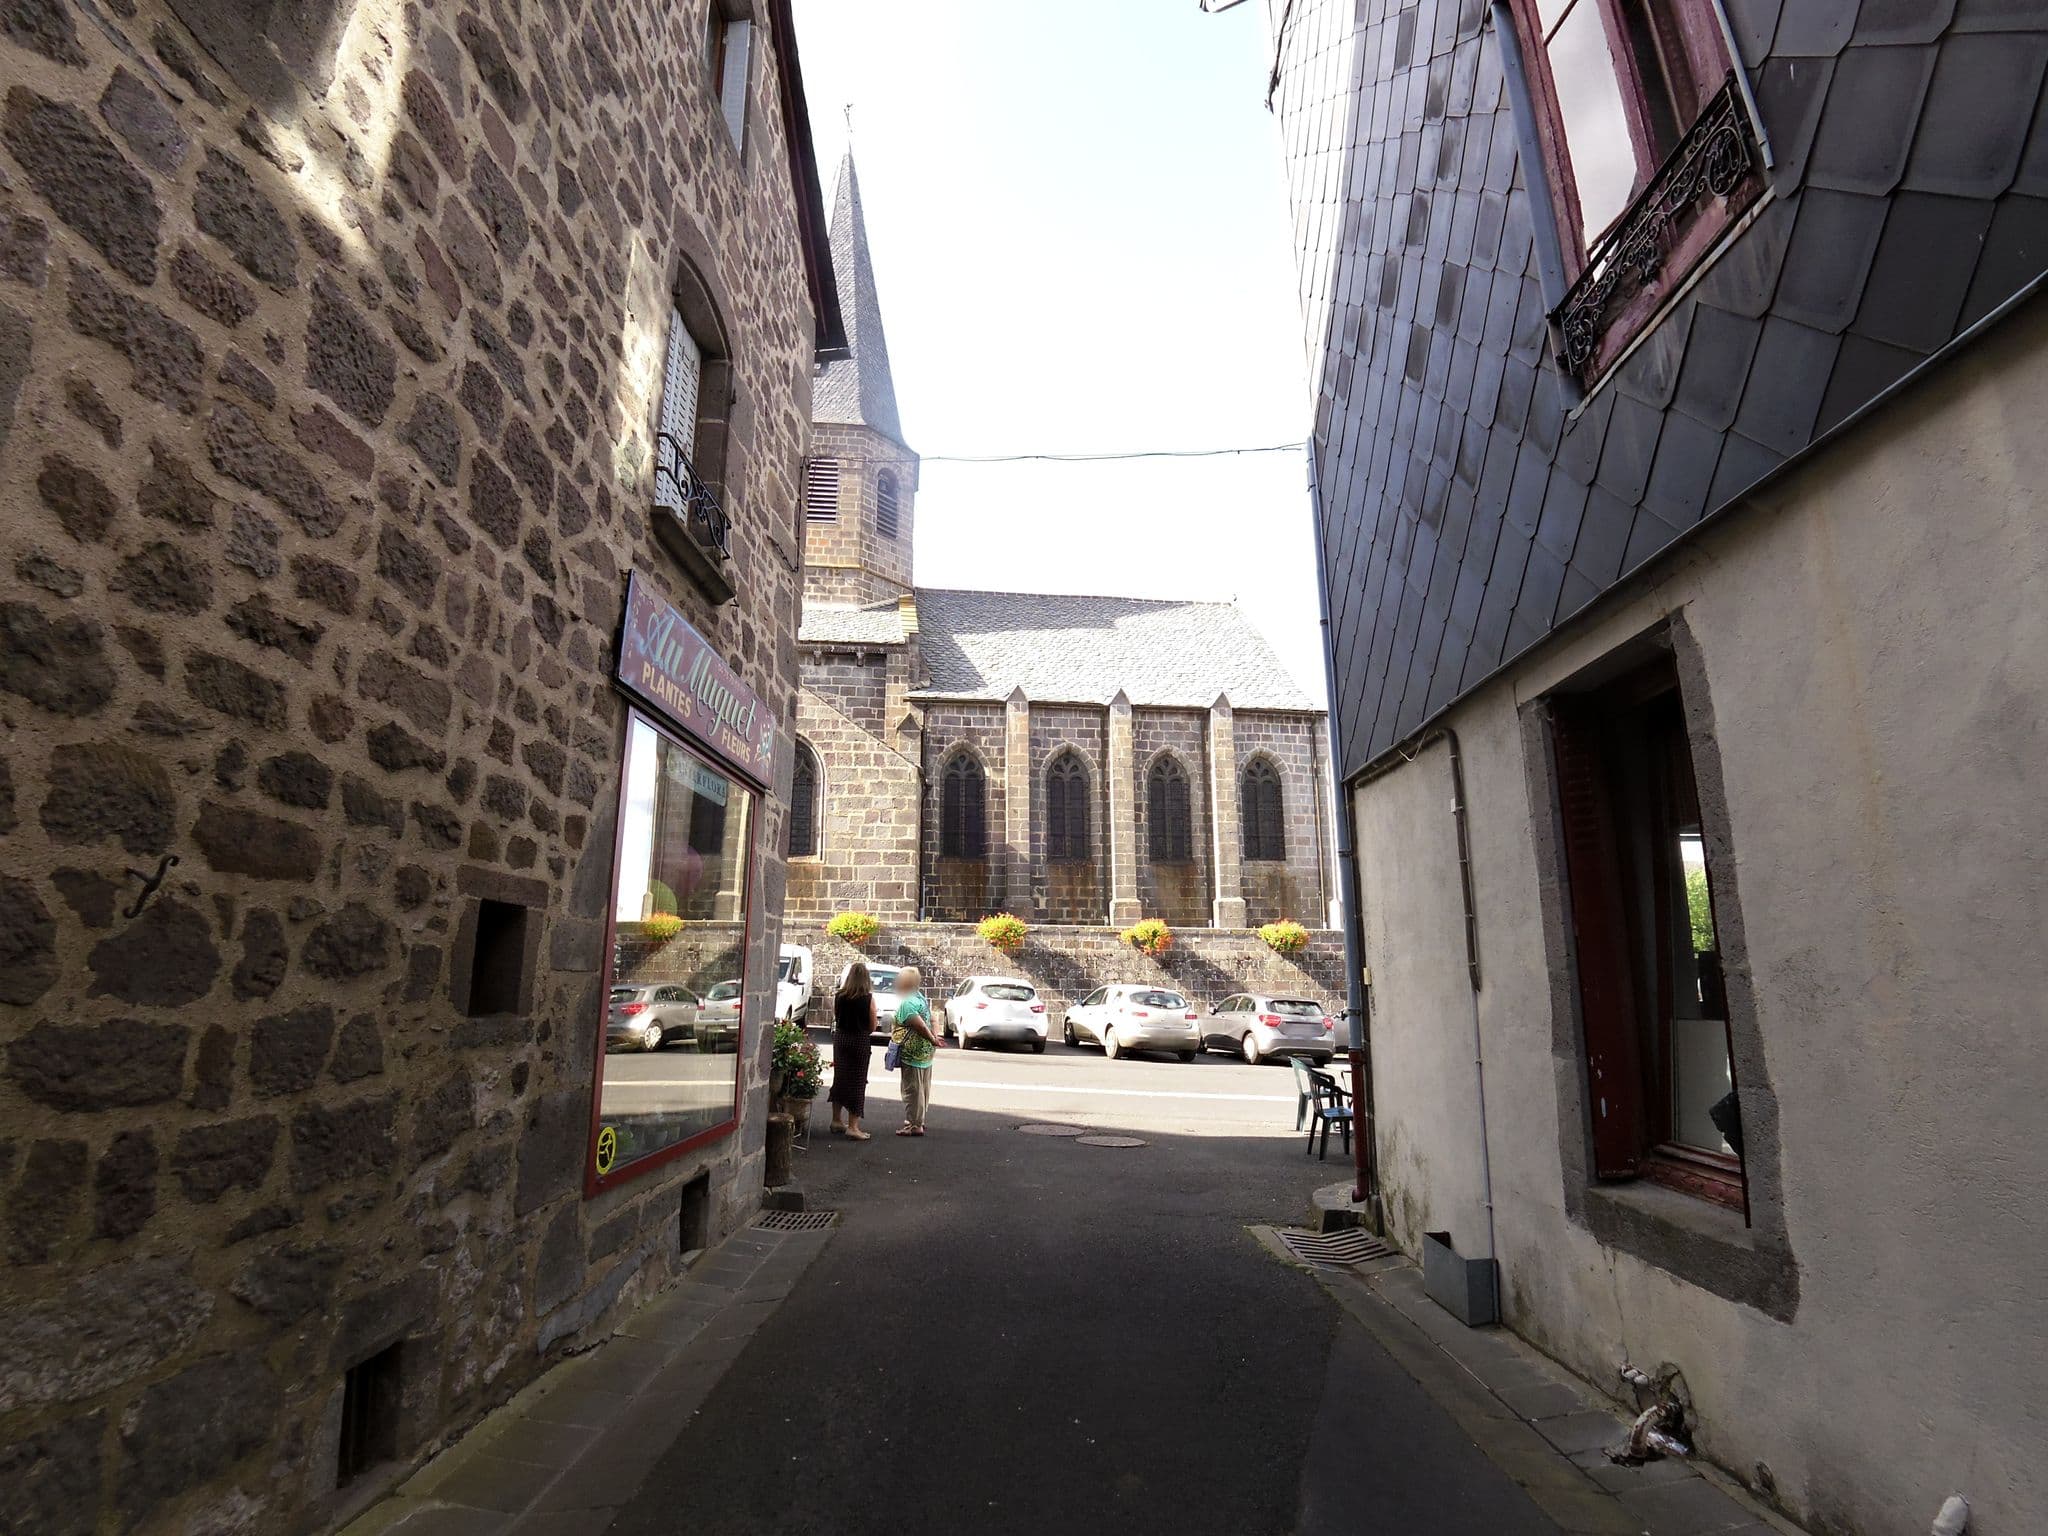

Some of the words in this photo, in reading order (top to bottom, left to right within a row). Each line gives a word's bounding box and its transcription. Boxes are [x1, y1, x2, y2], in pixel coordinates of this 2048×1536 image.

[640, 612, 683, 682] Au
[682, 648, 757, 742] Muguet
[642, 661, 692, 718] PLANTES
[721, 728, 751, 764] FLEURS
